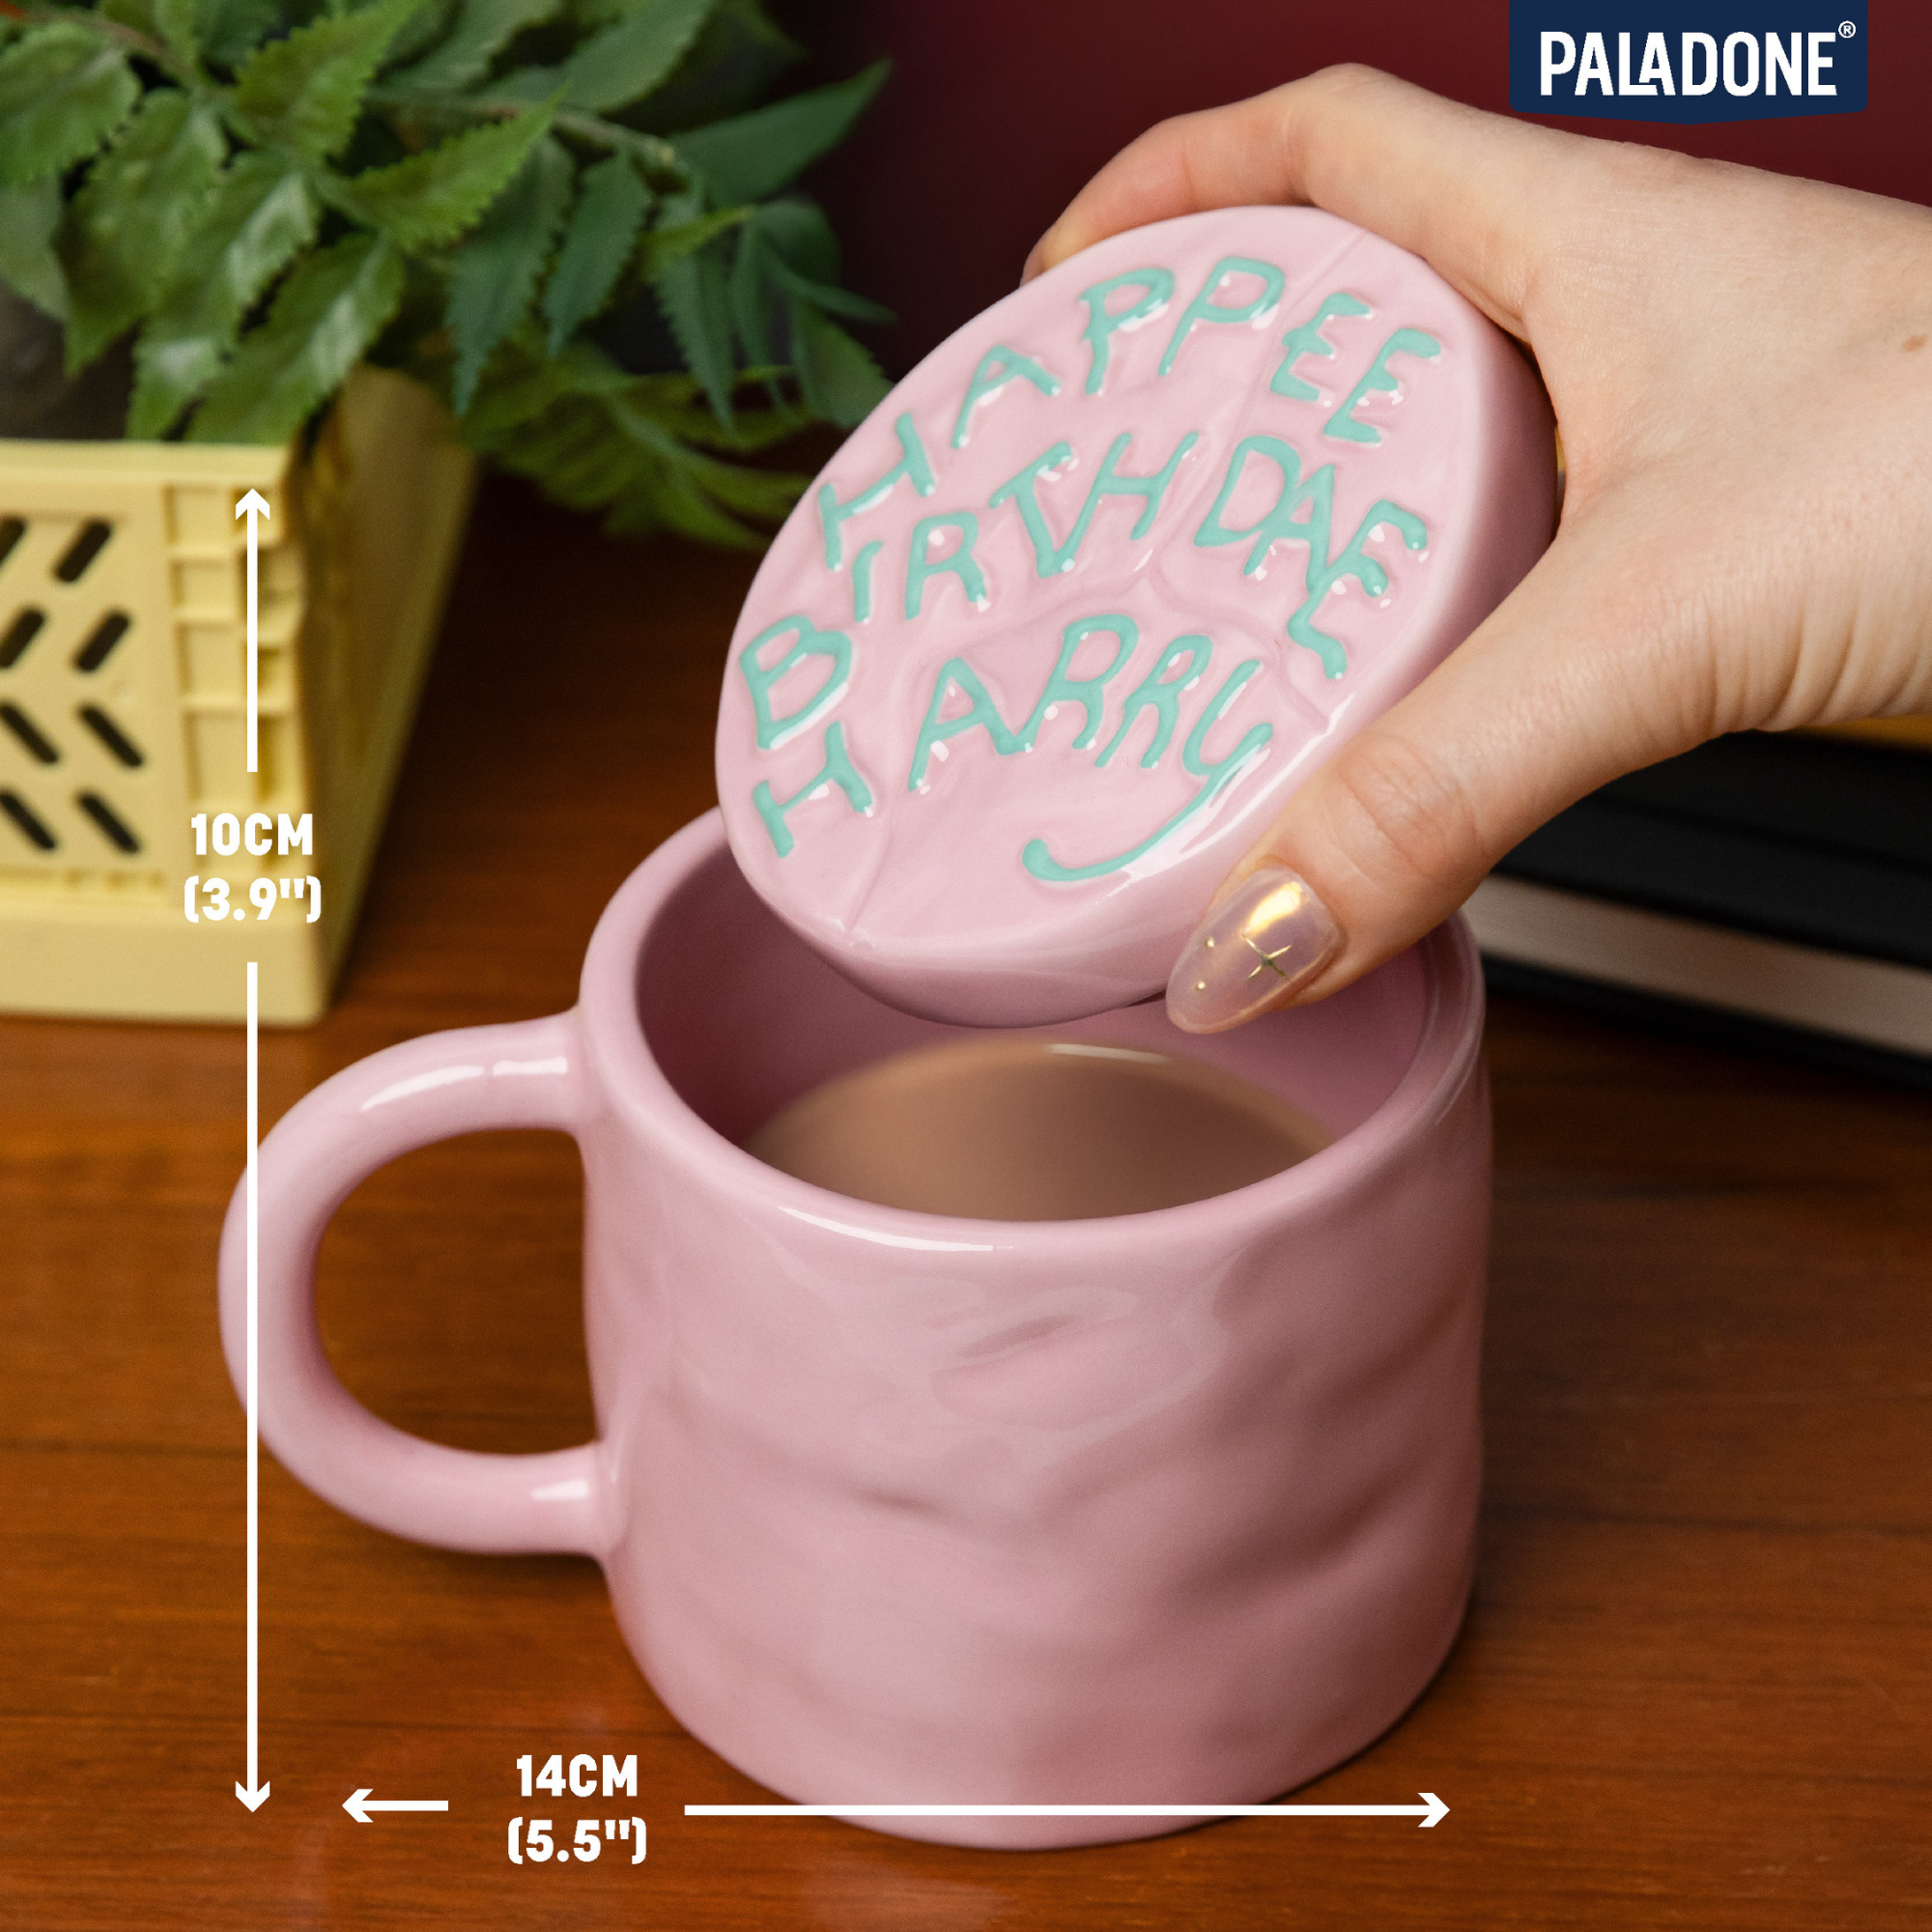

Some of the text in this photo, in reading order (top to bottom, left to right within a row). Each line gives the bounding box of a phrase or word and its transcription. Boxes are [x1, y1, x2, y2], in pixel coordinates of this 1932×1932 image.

[817, 255, 1442, 570] HAPPEE
[738, 431, 1430, 752] BIRTHDAE
[751, 614, 1274, 884] HARRY
